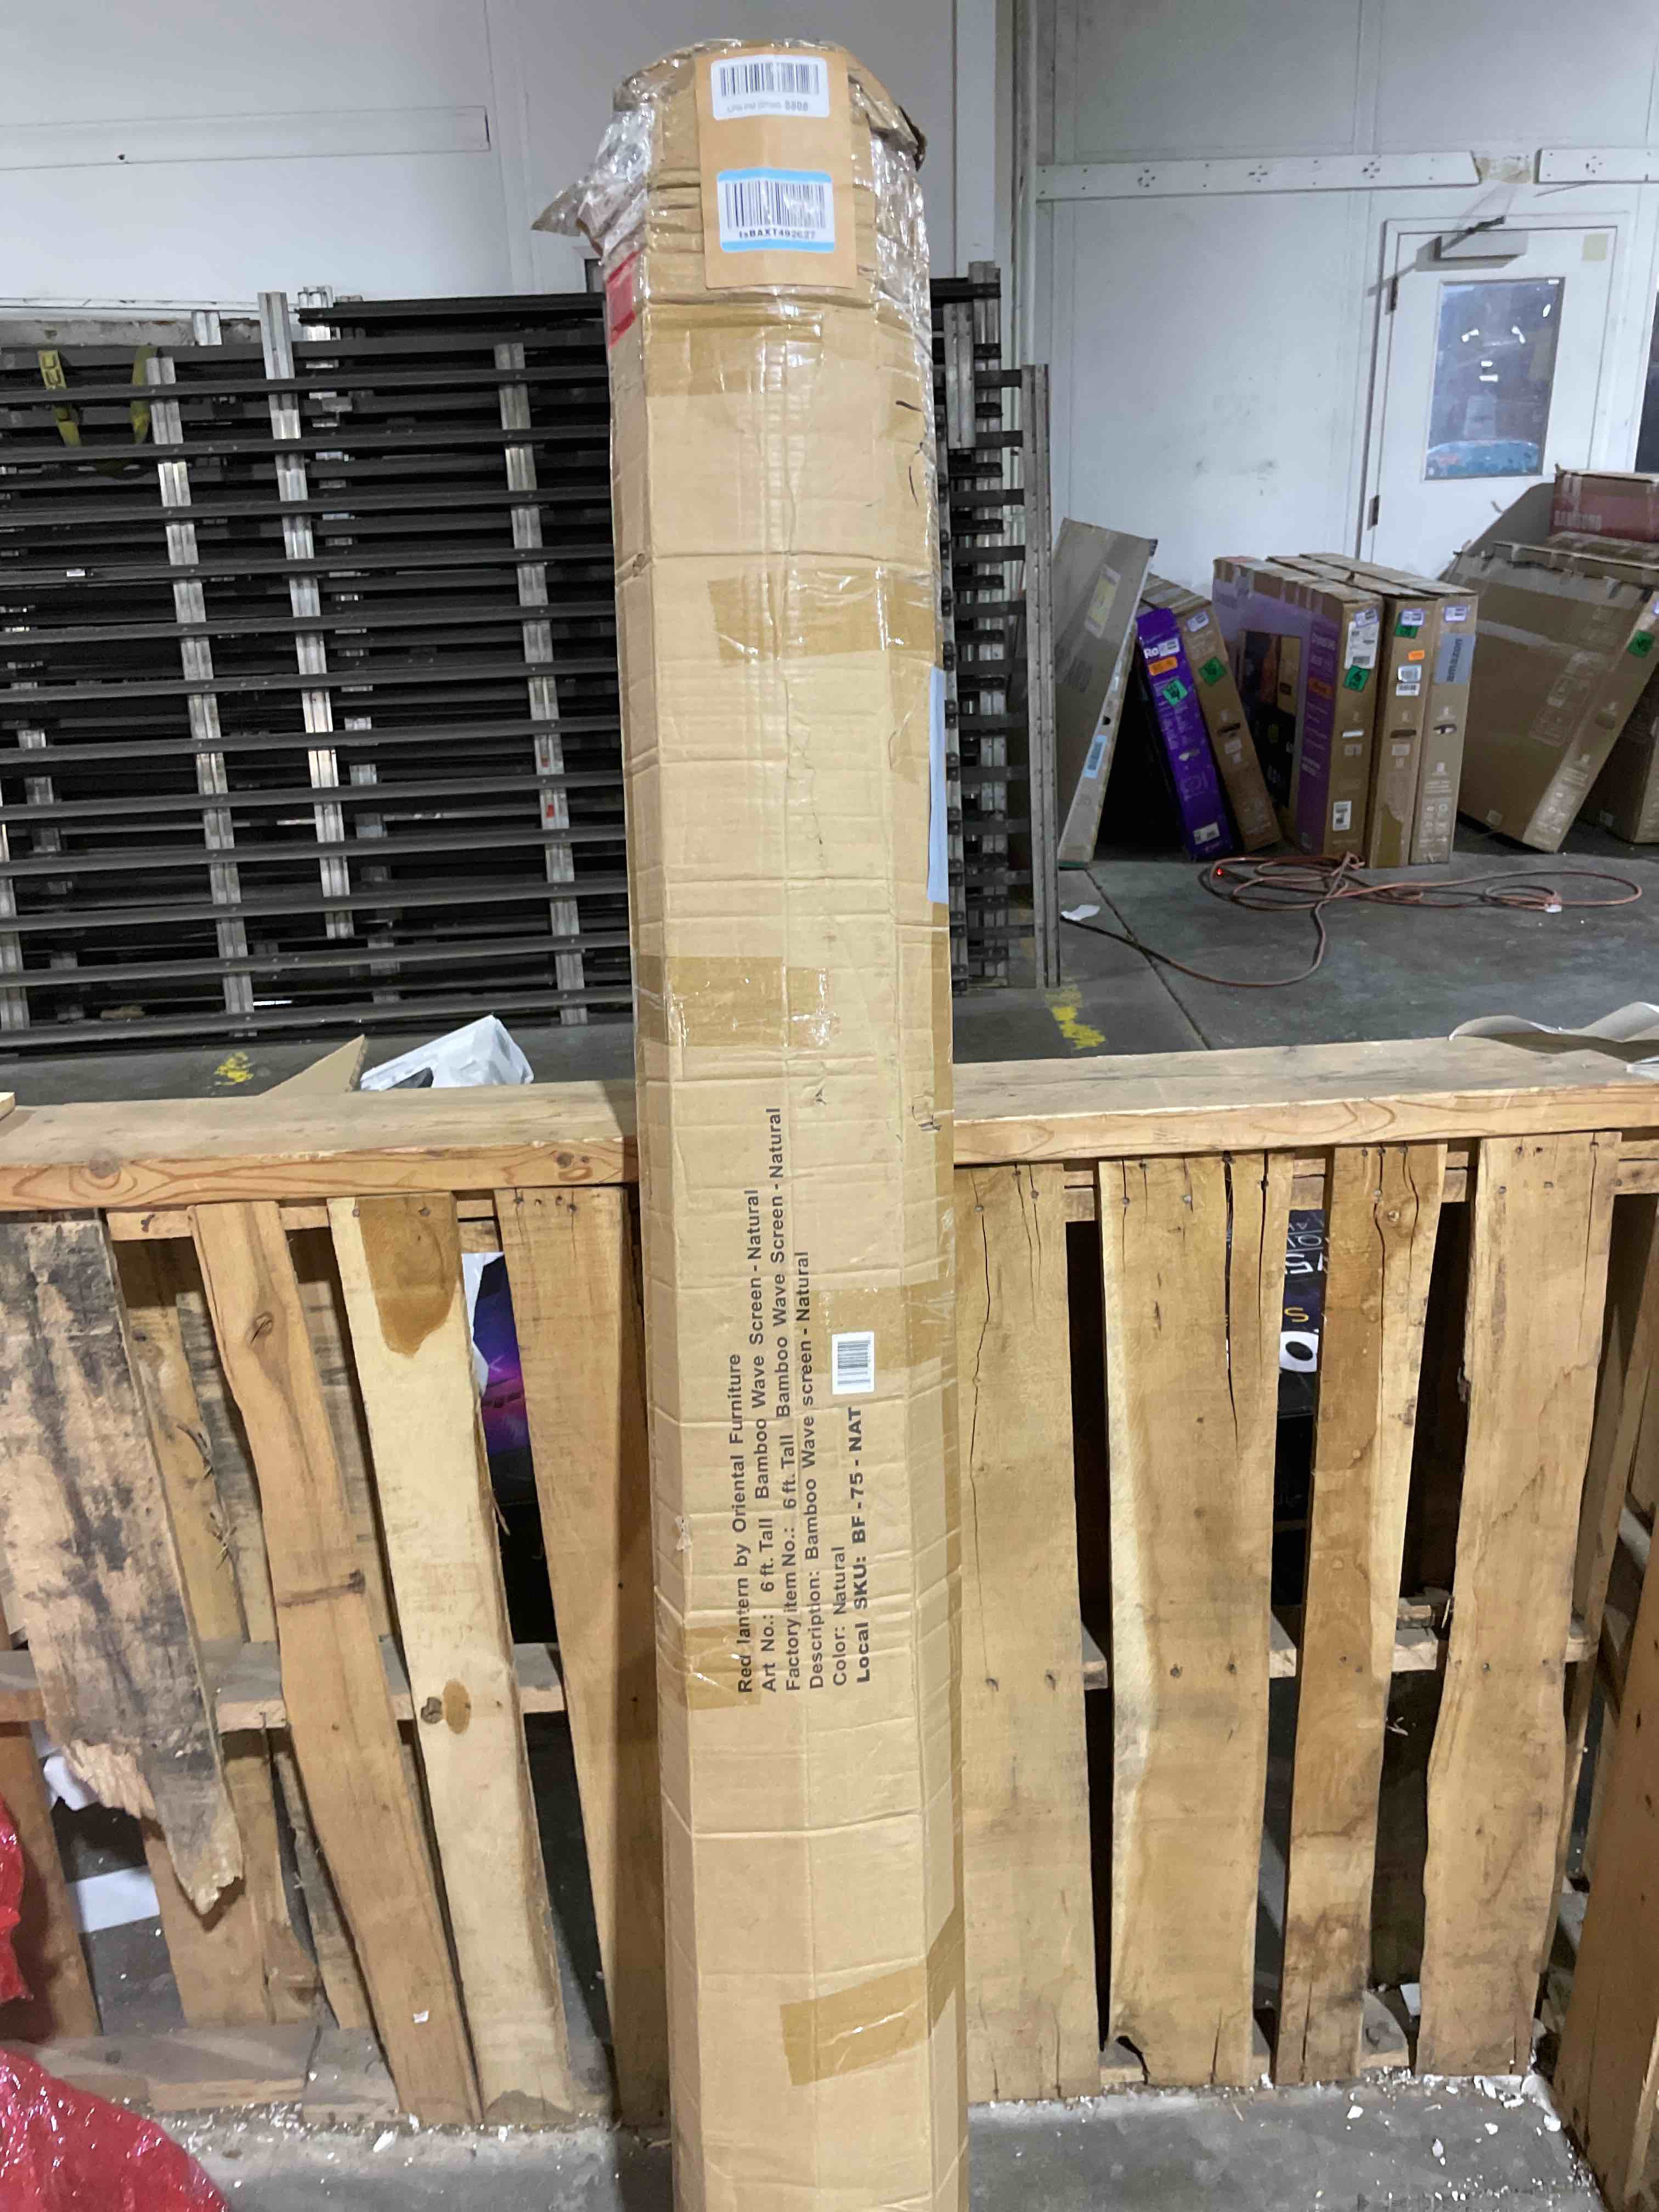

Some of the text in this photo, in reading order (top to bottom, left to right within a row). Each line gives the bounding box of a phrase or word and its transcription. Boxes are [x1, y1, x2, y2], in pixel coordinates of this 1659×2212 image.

[766, 1108, 783, 1178] Natural
[744, 1189, 762, 1260] Natural
[770, 1195, 785, 1263] Screen
[749, 1277, 764, 1345] Screen
[772, 1273, 787, 1327] Wave
[794, 1251, 810, 1322] Natural
[751, 1355, 766, 1409] Wave
[775, 1336, 791, 1418] Bamboo
[800, 1340, 814, 1407] screen
[753, 1418, 769, 1499] Bamboo
[779, 1434, 795, 1470] Tall
[801, 1415, 816, 1469] Wave
[727, 1353, 752, 1693] Red lantern by Oriental Furniture
[758, 1518, 773, 1553] Tall
[781, 1527, 796, 1566] No.:
[804, 1478, 819, 1560] Bamboo
[783, 1572, 797, 1613] item
[831, 1546, 847, 1686] Color: Natural
[852, 1556, 868, 1610] SKU:
[761, 1615, 775, 1652] No.:
[786, 1618, 802, 1691] Factory
[808, 1571, 825, 1689] Description:
[855, 1622, 870, 1683] Local
[761, 1662, 777, 1692] Art
